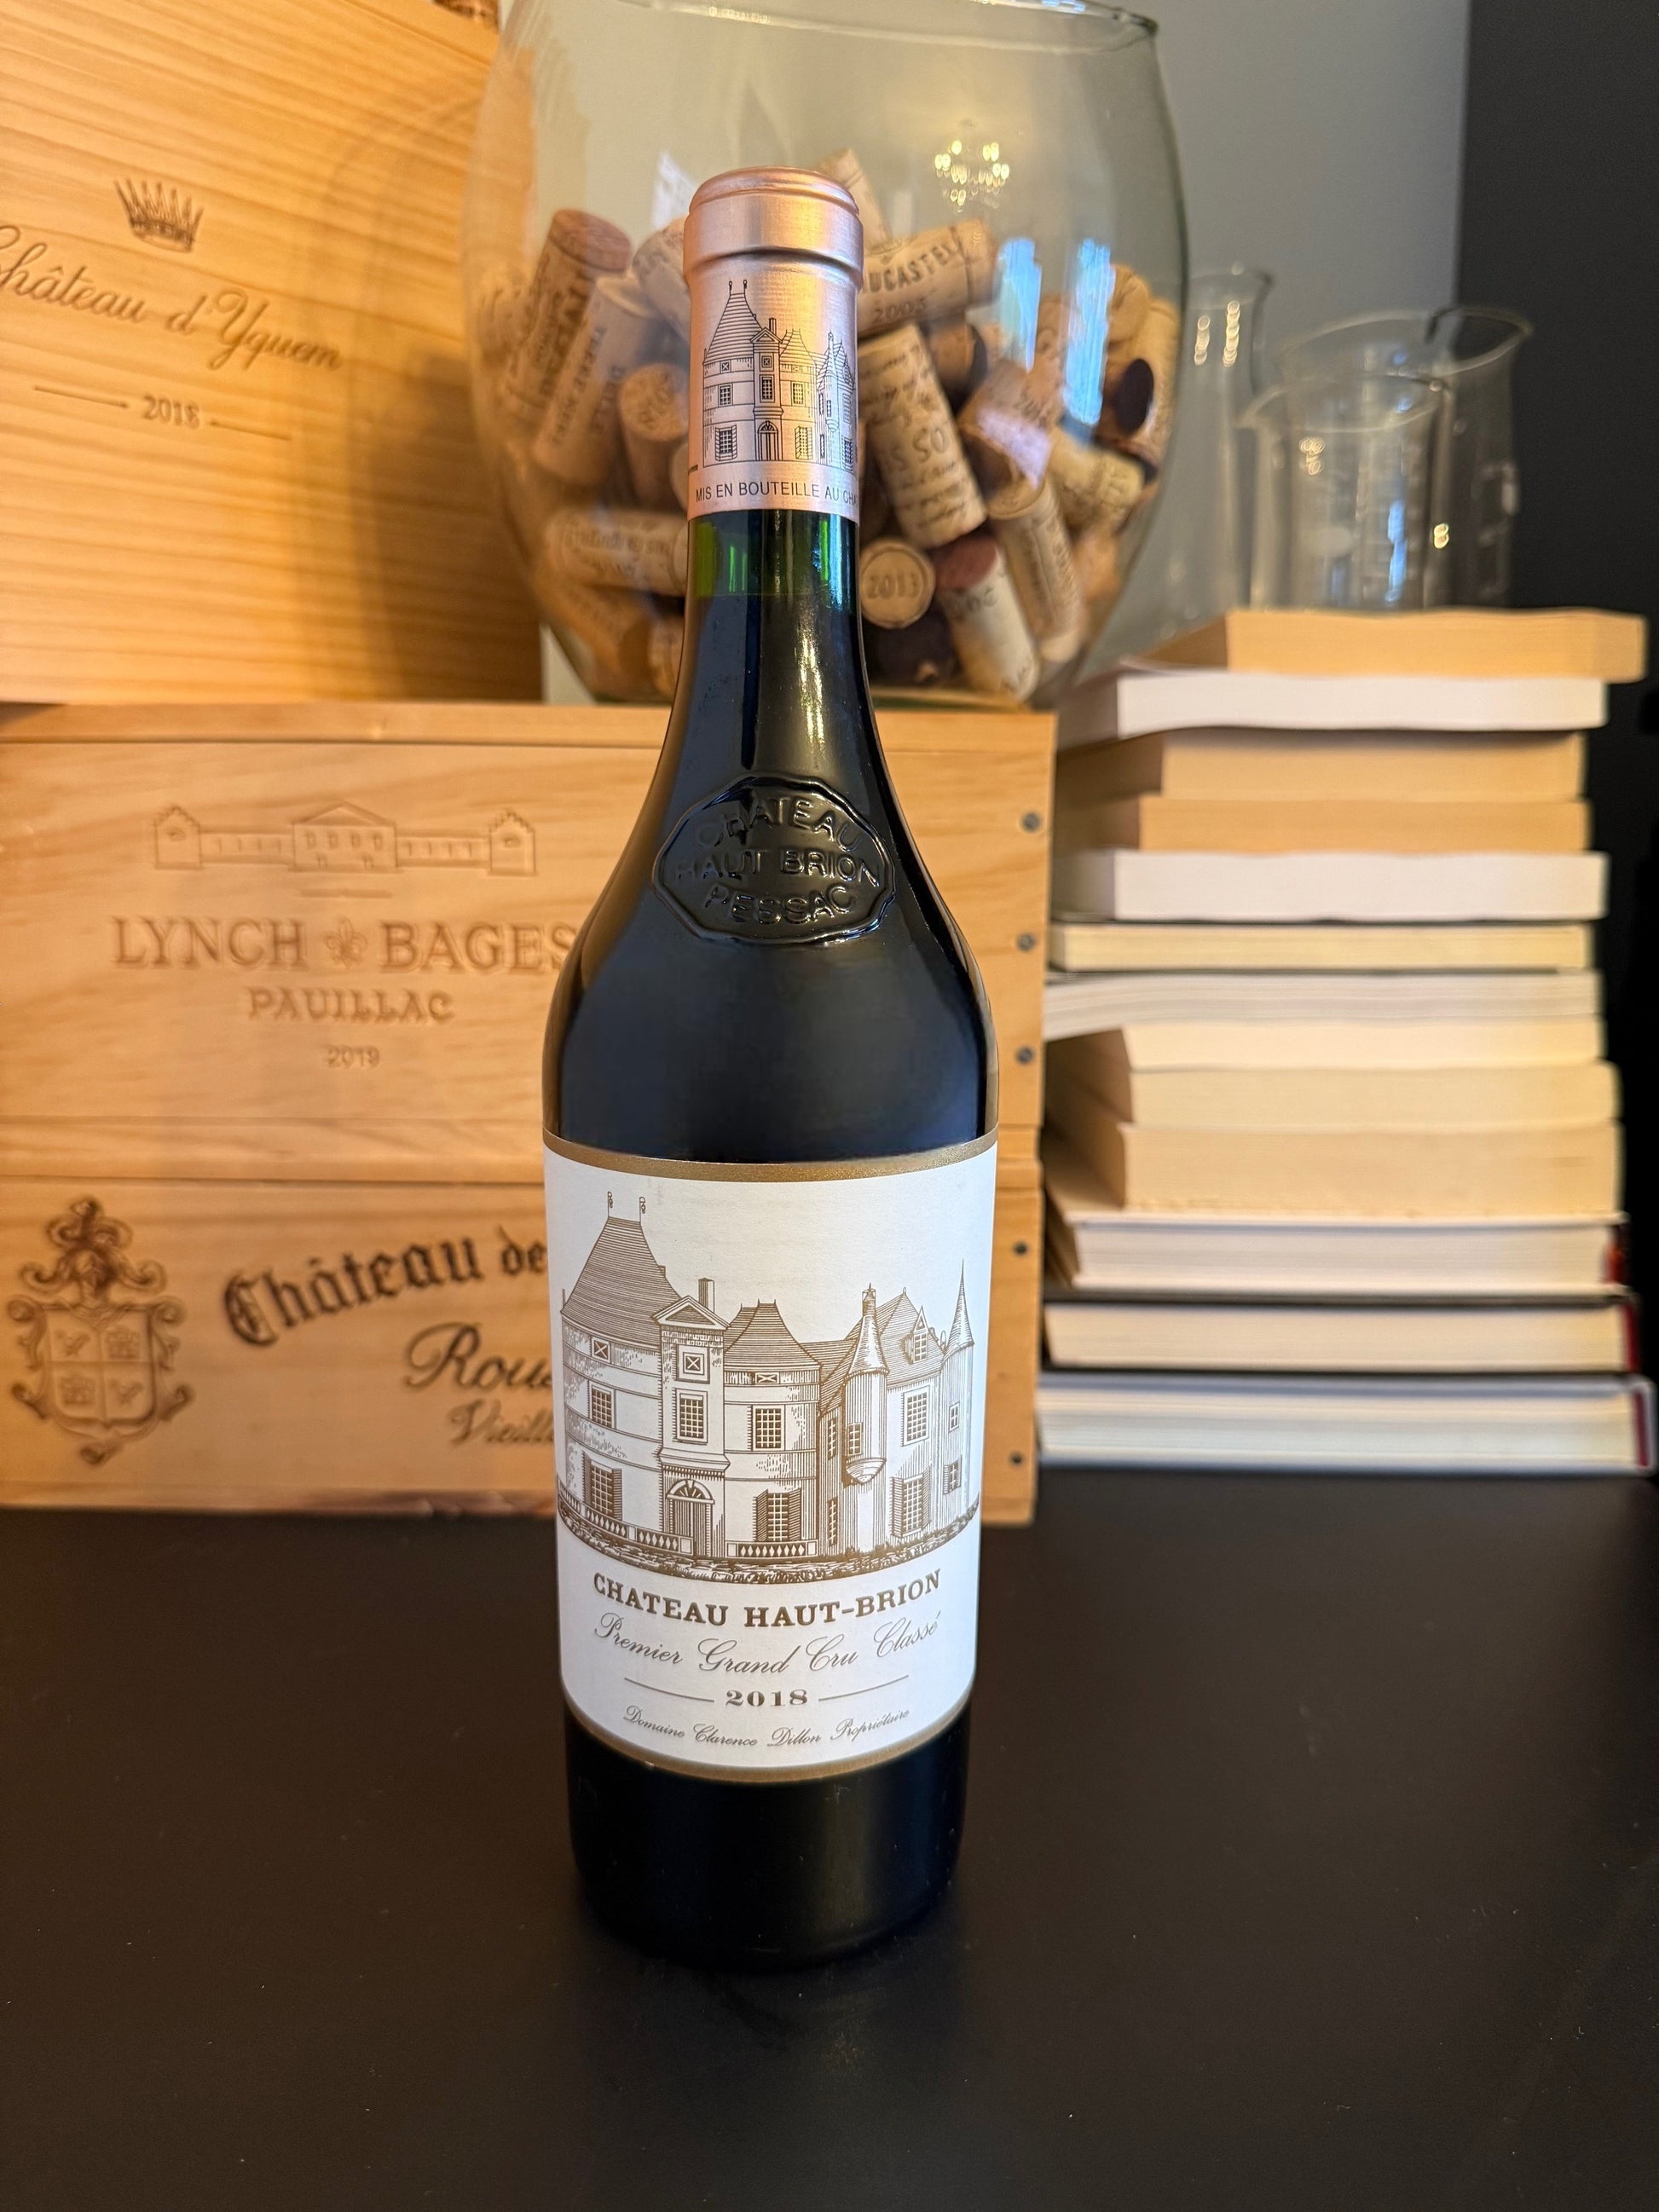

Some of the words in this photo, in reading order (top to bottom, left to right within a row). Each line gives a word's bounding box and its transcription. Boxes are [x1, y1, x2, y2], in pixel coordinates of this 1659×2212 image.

[142, 394, 201, 428] 2018
[696, 486, 712, 502] MIS
[716, 482, 733, 498] EN
[739, 482, 819, 498] BOUTEILLE
[825, 486, 839, 501] AU
[676, 850, 763, 881] HAUT
[780, 849, 880, 888] BRION
[705, 883, 856, 925] PESSAC
[111, 915, 309, 971] LYNCH
[380, 920, 580, 973] BAGES
[247, 986, 454, 1024] PAUILLAC
[326, 1045, 380, 1069] 2019
[222, 1236, 485, 1347] Château
[592, 1570, 729, 1627] CHATEAU
[743, 1568, 941, 1627] HAUT-BRION
[594, 1611, 684, 1665] Premier
[697, 1637, 802, 1674] Grand
[805, 1633, 858, 1672] Cru
[873, 1610, 941, 1658] Classé
[725, 1689, 808, 1707] 2018
[623, 1705, 685, 1737] Domaine
[693, 1723, 758, 1746] Clarence
[766, 1726, 822, 1747] Dillon
[830, 1708, 910, 1741] Propriétaire
